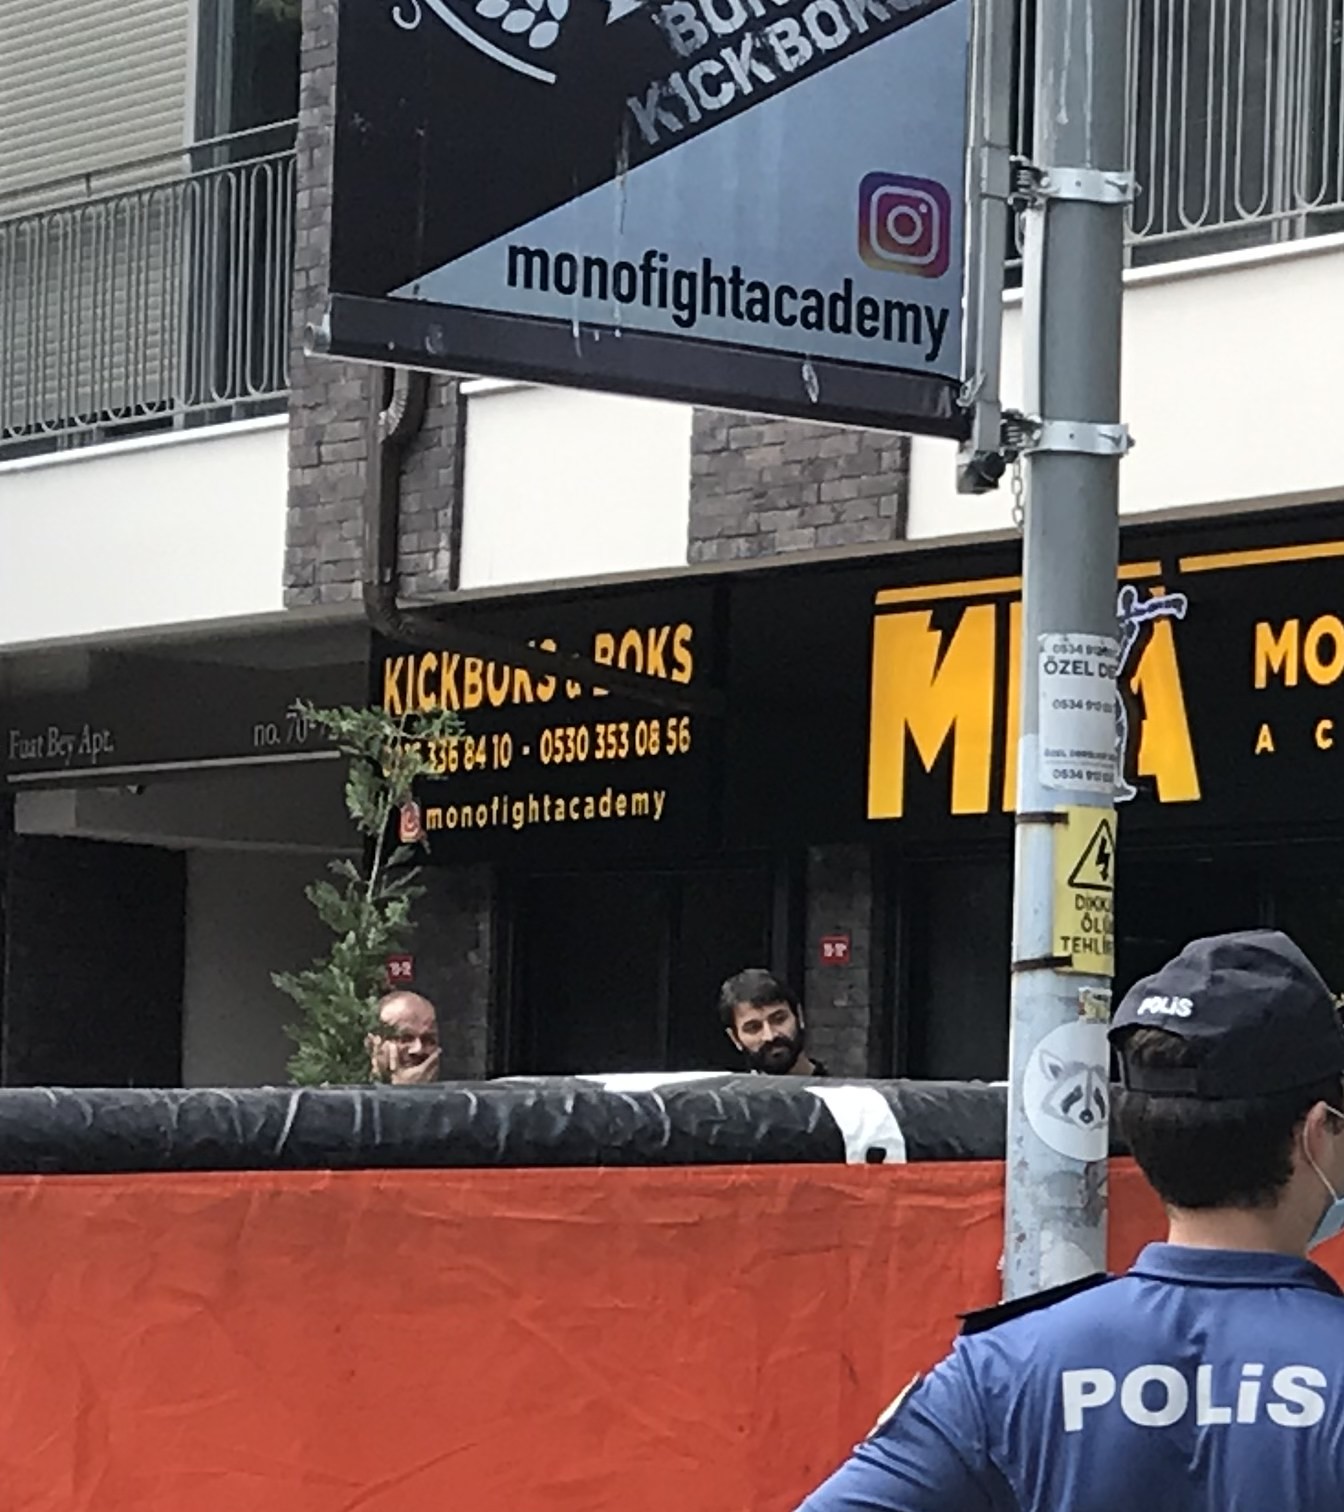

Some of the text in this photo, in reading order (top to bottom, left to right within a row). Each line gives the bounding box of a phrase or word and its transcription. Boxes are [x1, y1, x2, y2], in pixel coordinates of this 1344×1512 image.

[507, 243, 949, 361] monofightacademy
[492, 732, 513, 770] 10
[540, 725, 589, 764] 0530
[594, 722, 629, 760] 353
[635, 719, 660, 756] 08
[665, 716, 691, 755] 56
[426, 787, 666, 830] monofightacademy
